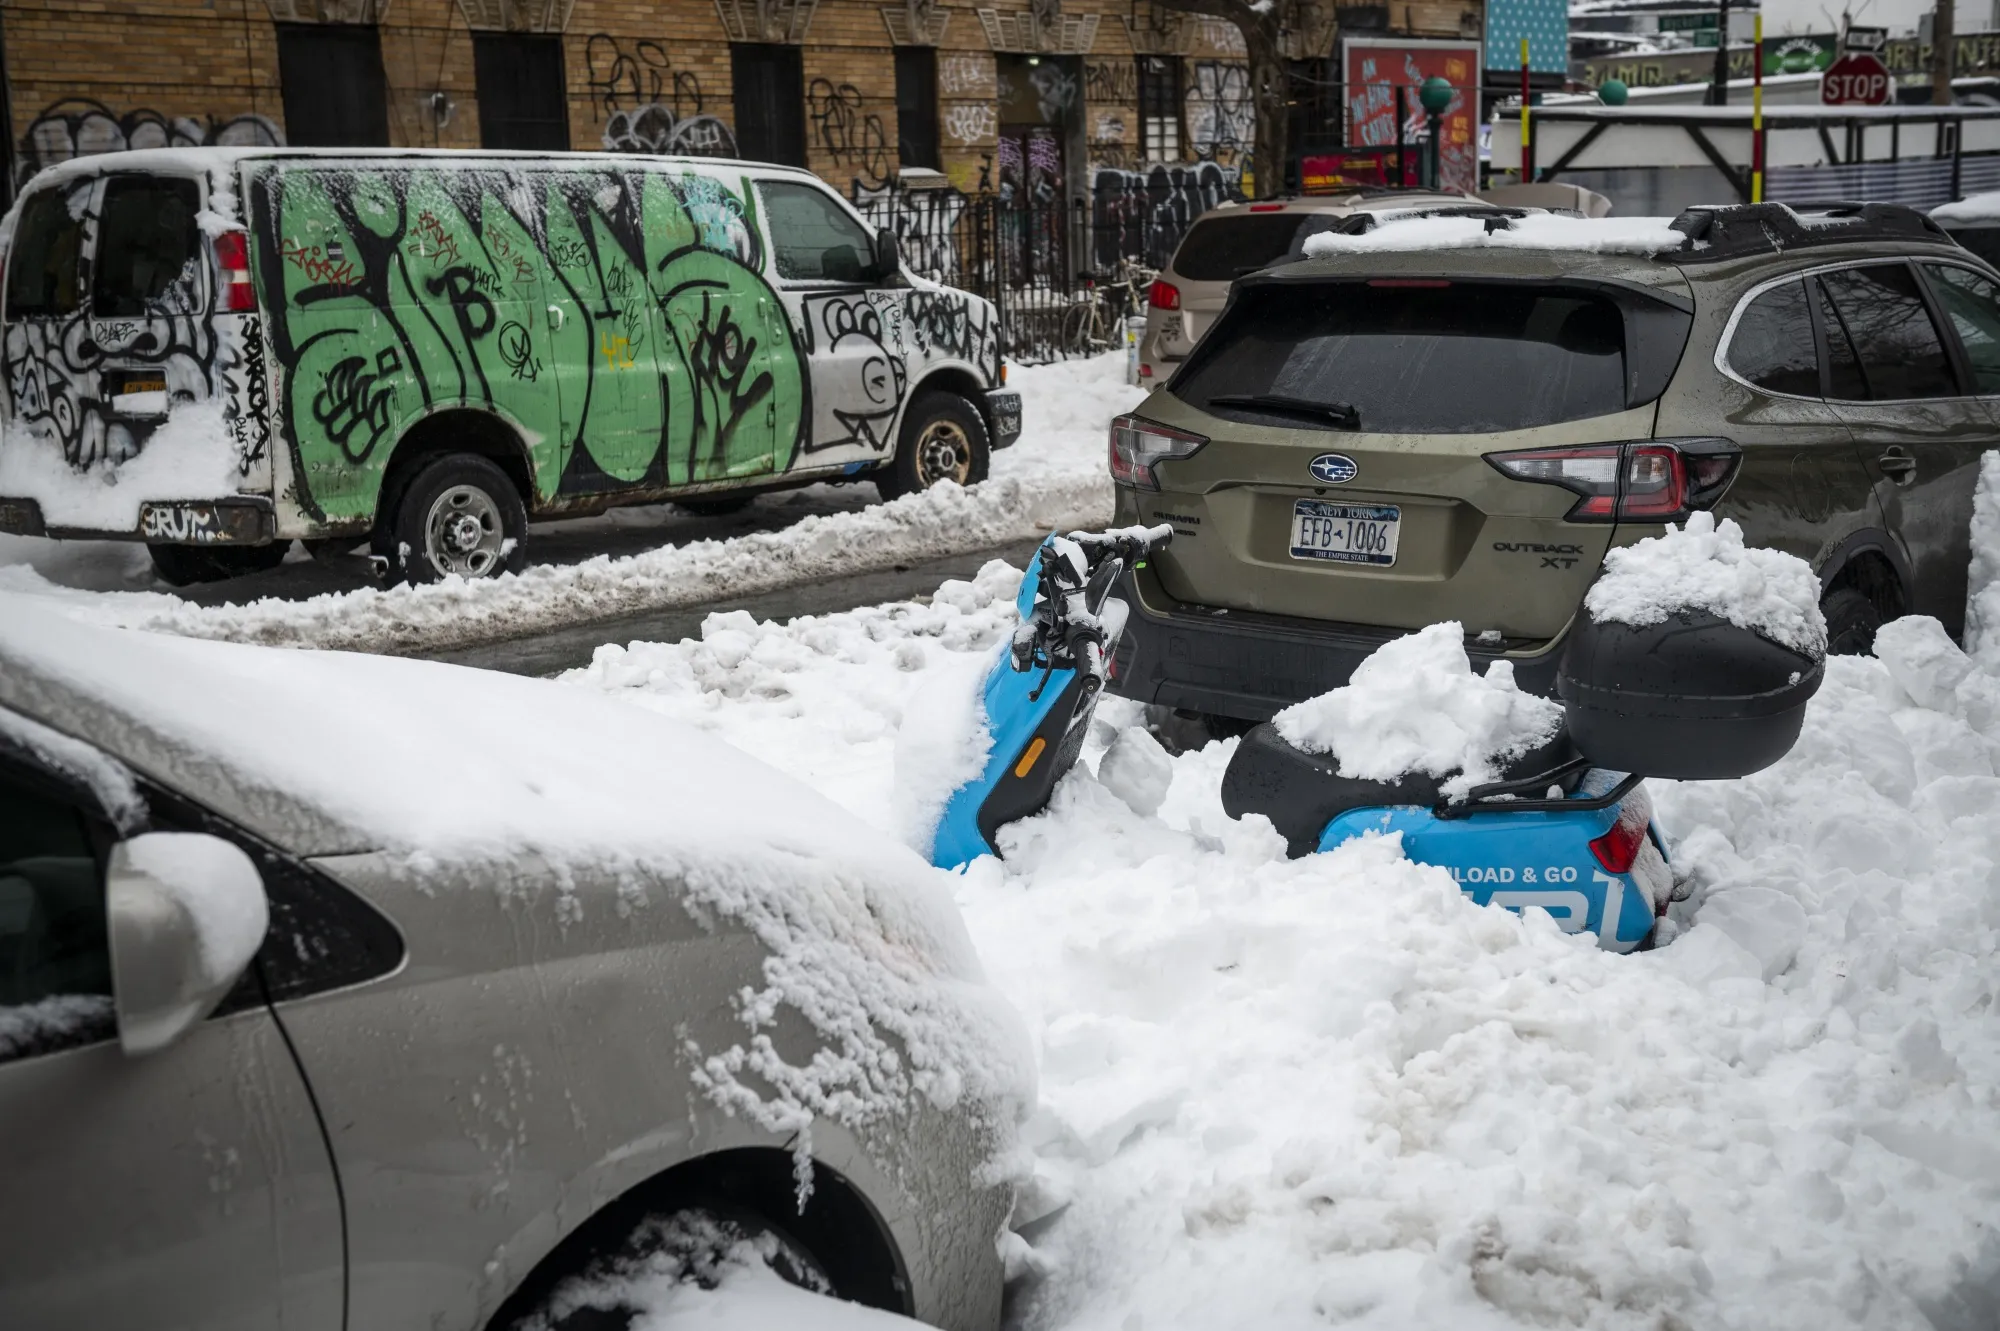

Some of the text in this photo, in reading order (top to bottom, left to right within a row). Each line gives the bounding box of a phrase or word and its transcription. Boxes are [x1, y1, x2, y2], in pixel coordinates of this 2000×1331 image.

[1826, 74, 1885, 99] STOP
[1319, 505, 1374, 520] NEW YORK
[1300, 516, 1388, 552] EFB 1006
[1315, 550, 1369, 562] THE EMPIRE STATE
[1492, 542, 1584, 555] OUTBACK
[1540, 556, 1579, 570] XT
[1522, 867, 1538, 883] &
[1544, 866, 1578, 883] GO
